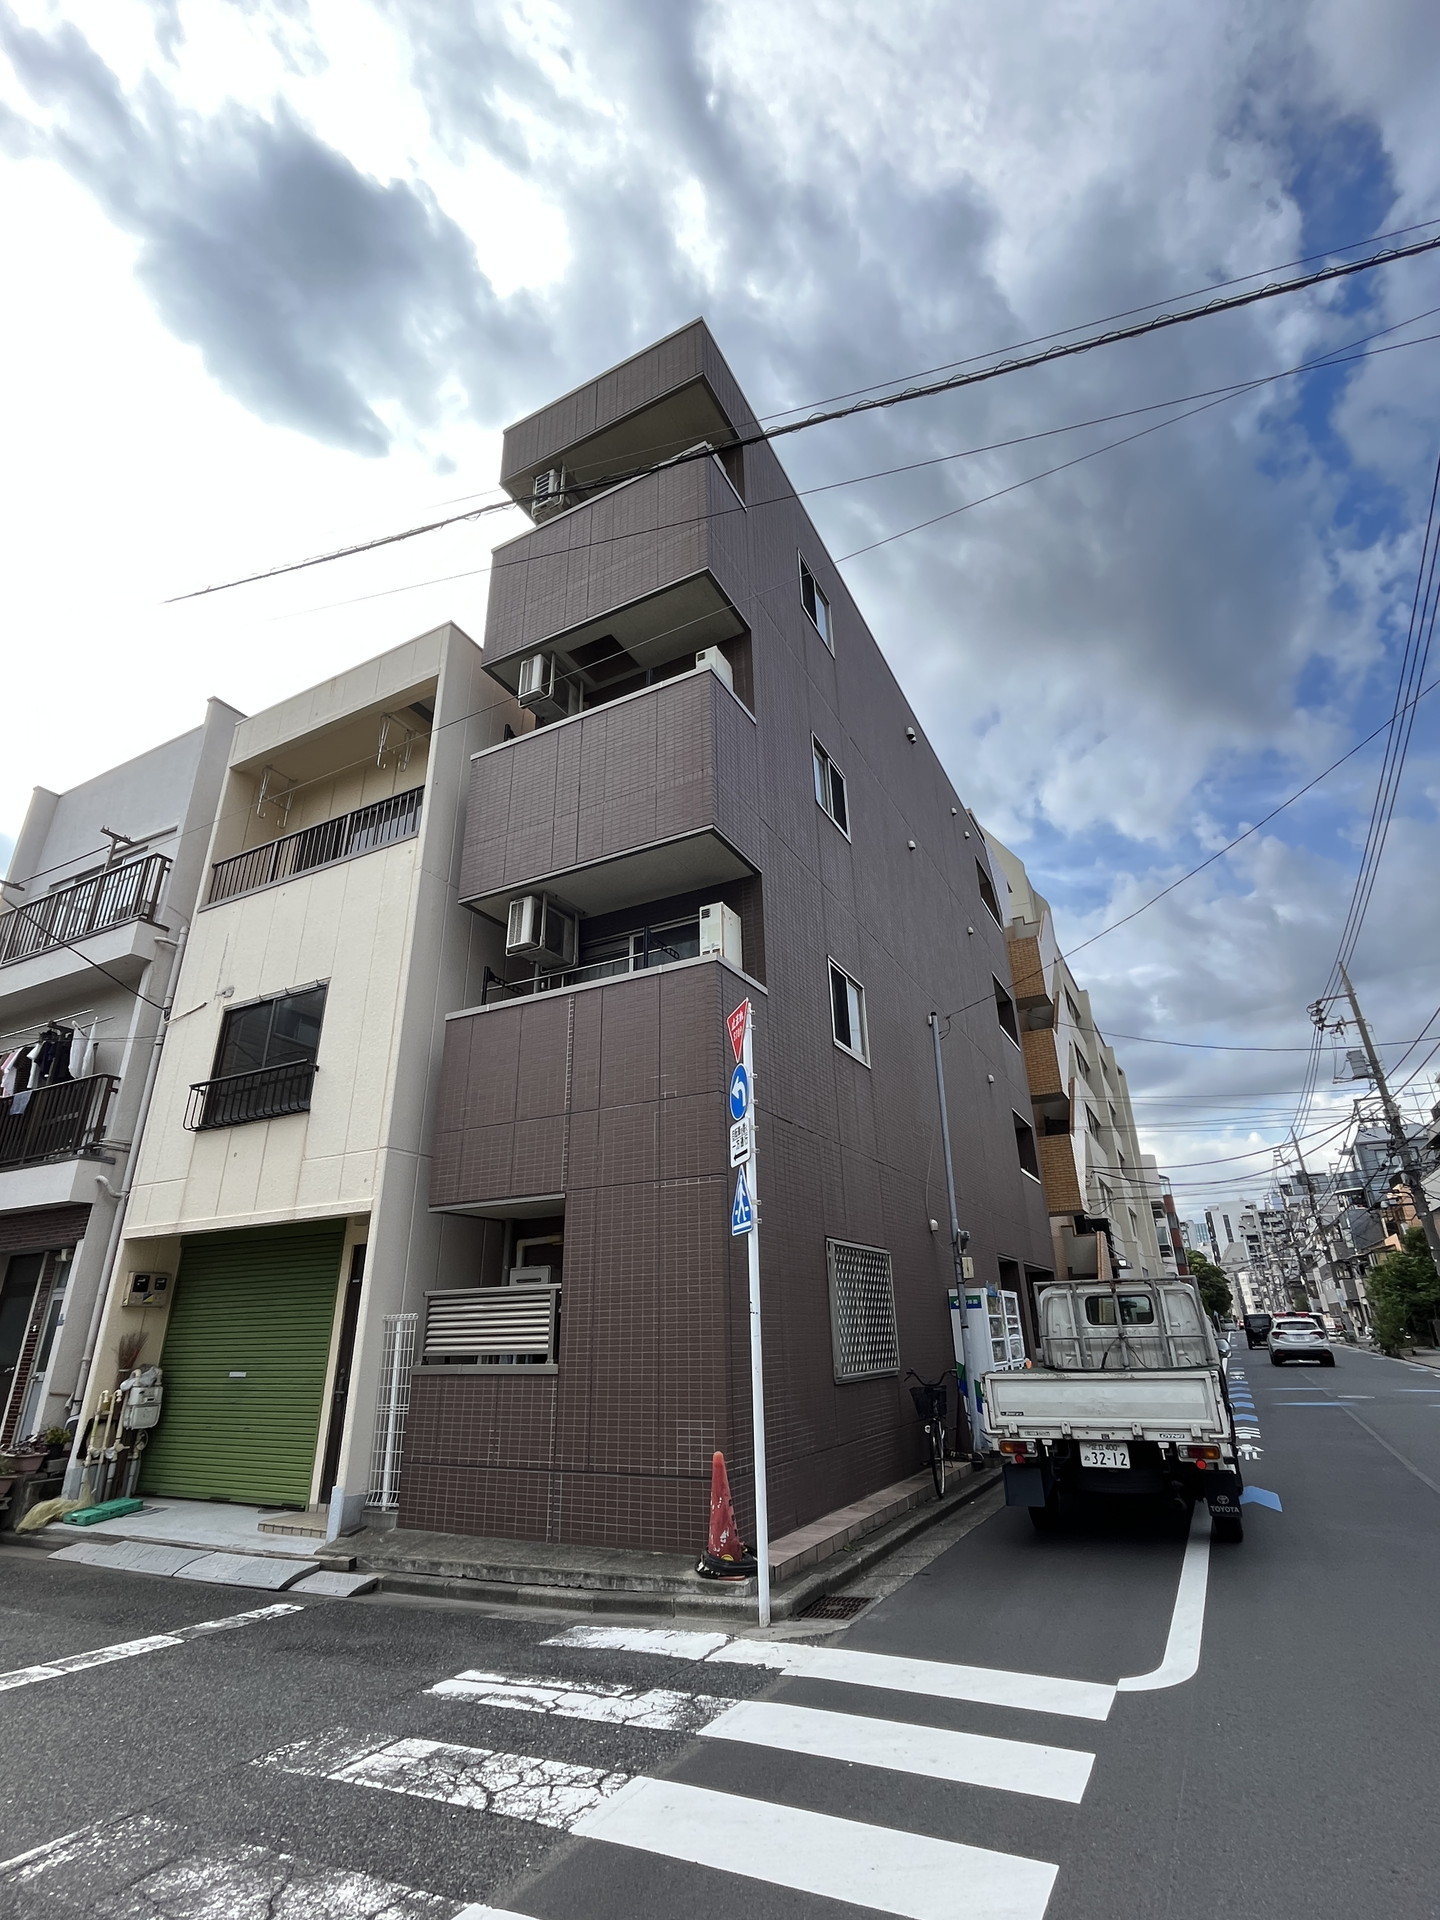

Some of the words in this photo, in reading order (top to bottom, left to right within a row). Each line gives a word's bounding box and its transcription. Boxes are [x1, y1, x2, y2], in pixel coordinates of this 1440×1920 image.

[731, 1010, 744, 1031] 止まれ
[733, 1025, 743, 1041] STOP
[1091, 1452, 1128, 1467] 32-12
[1210, 1505, 1240, 1513] TOYOTA
